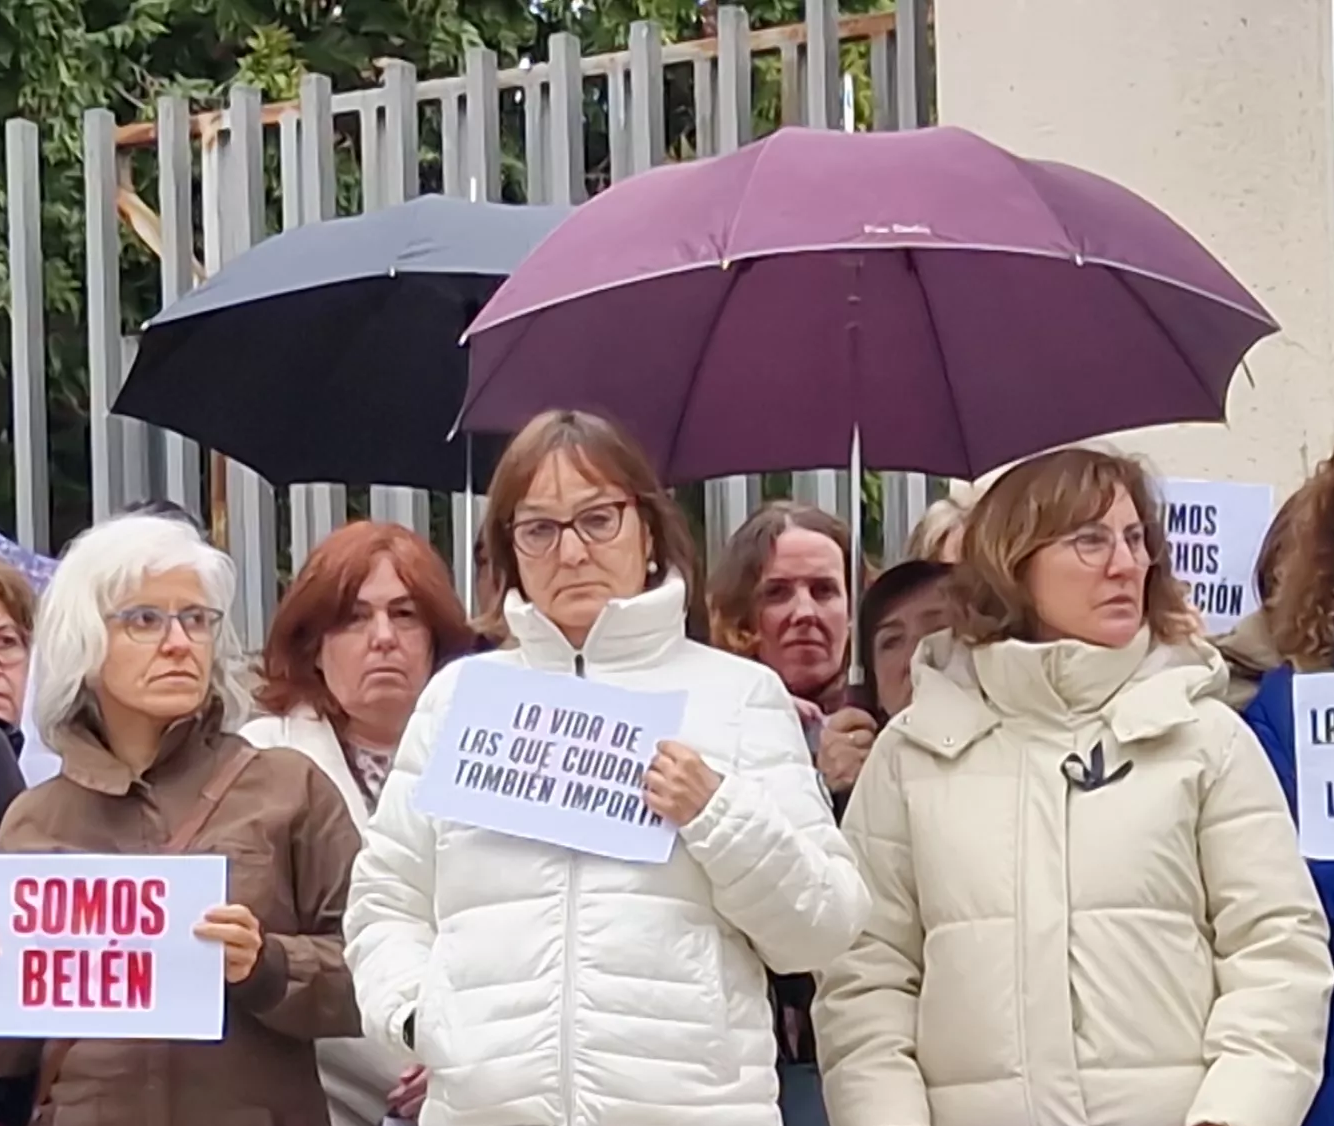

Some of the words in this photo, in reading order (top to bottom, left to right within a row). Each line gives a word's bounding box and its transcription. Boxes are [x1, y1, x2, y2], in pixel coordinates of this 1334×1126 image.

[1164, 503, 1217, 536] MOS
[1190, 577, 1243, 616] CIÓN
[459, 727, 504, 756] LAS
[509, 736, 557, 768] QUE
[513, 702, 542, 731] LA
[550, 707, 605, 743] VIDA
[610, 721, 643, 753] DE
[12, 877, 166, 936] SOMOS
[22, 939, 153, 1010] BELÉN
